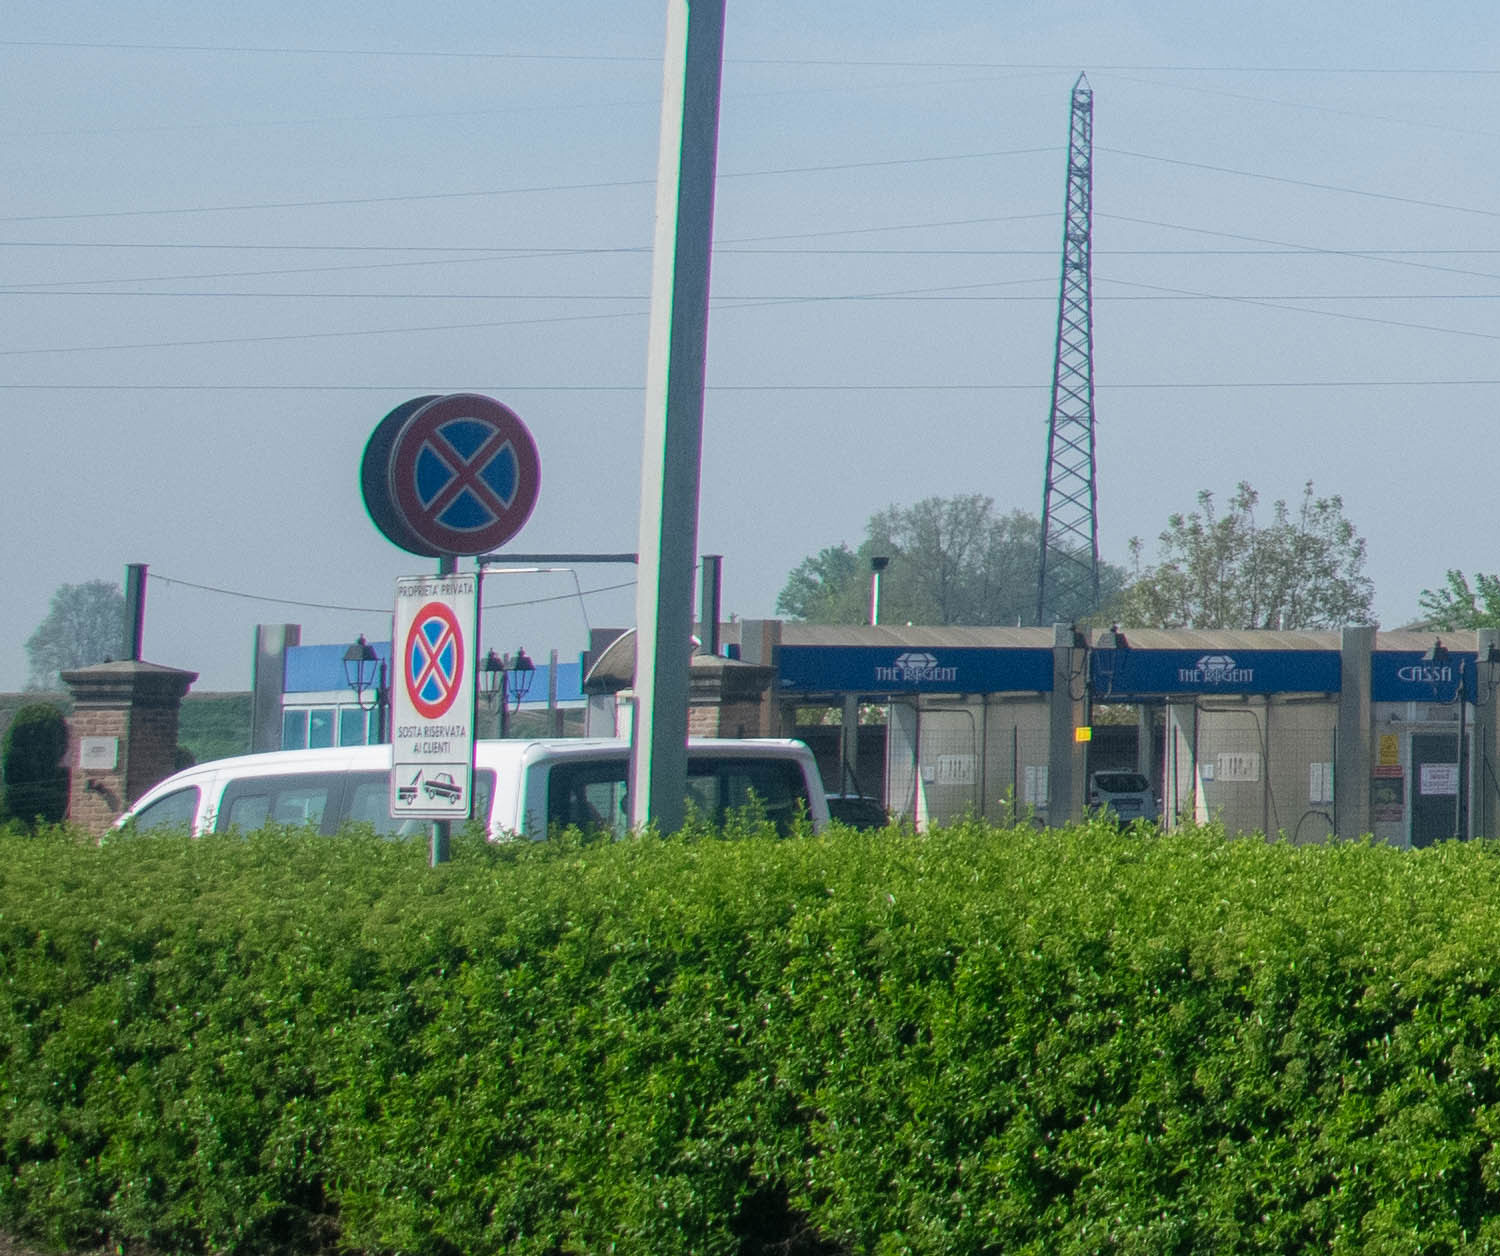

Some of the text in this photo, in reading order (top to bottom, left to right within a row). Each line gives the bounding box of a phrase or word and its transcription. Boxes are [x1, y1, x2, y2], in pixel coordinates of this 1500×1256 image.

[442, 583, 473, 594] PRIVATA
[876, 667, 958, 682] THE REGENT
[1179, 669, 1254, 683] THE REGENT
[1398, 666, 1452, 681] CASSA
[398, 725, 466, 738] SOSTA RISERVATA
[413, 741, 451, 753] AI CLIENTI
